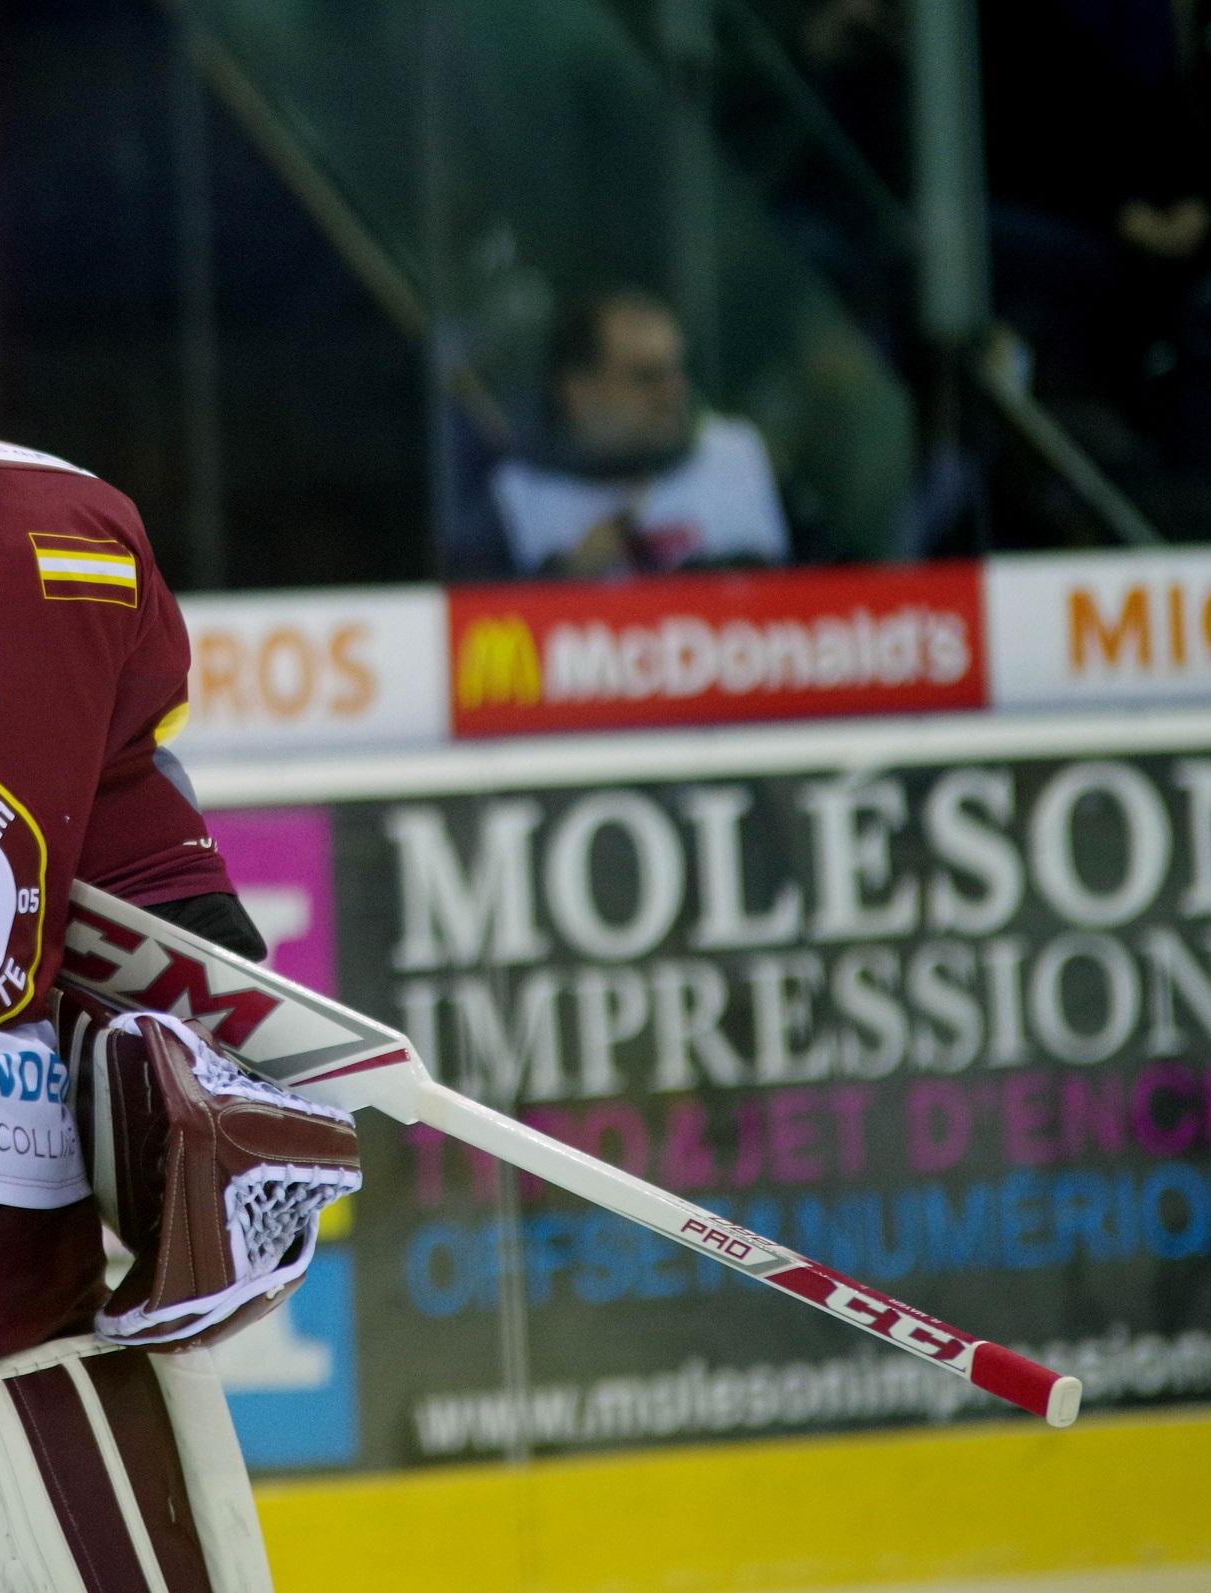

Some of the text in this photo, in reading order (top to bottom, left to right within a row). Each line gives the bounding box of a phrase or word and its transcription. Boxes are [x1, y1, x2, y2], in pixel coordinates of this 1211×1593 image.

[544, 608, 970, 705] McDonald's
[1067, 580, 1211, 675] MI
[17, 887, 40, 914] 05
[387, 757, 1211, 969] MOLÉSO
[680, 1218, 754, 1261] PRO
